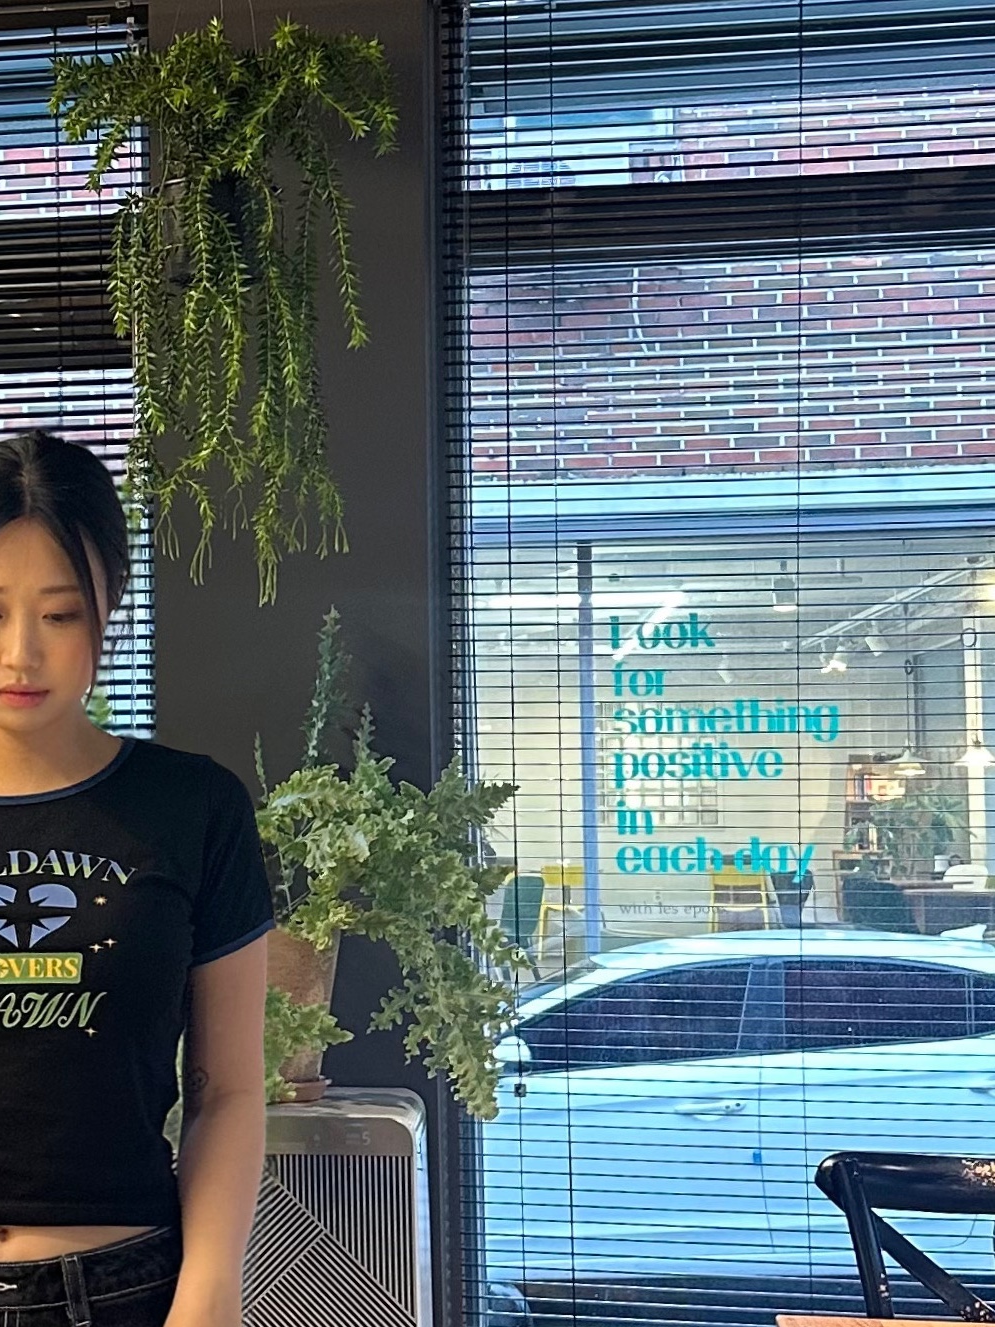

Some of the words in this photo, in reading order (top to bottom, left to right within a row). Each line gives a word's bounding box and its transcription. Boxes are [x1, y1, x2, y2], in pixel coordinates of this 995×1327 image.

[609, 612, 716, 650] Look
[612, 661, 669, 697] for
[614, 697, 839, 743] something
[614, 742, 783, 789] positive
[617, 800, 654, 835] in
[616, 836, 723, 873] each
[734, 836, 815, 884] day
[619, 900, 652, 914] with
